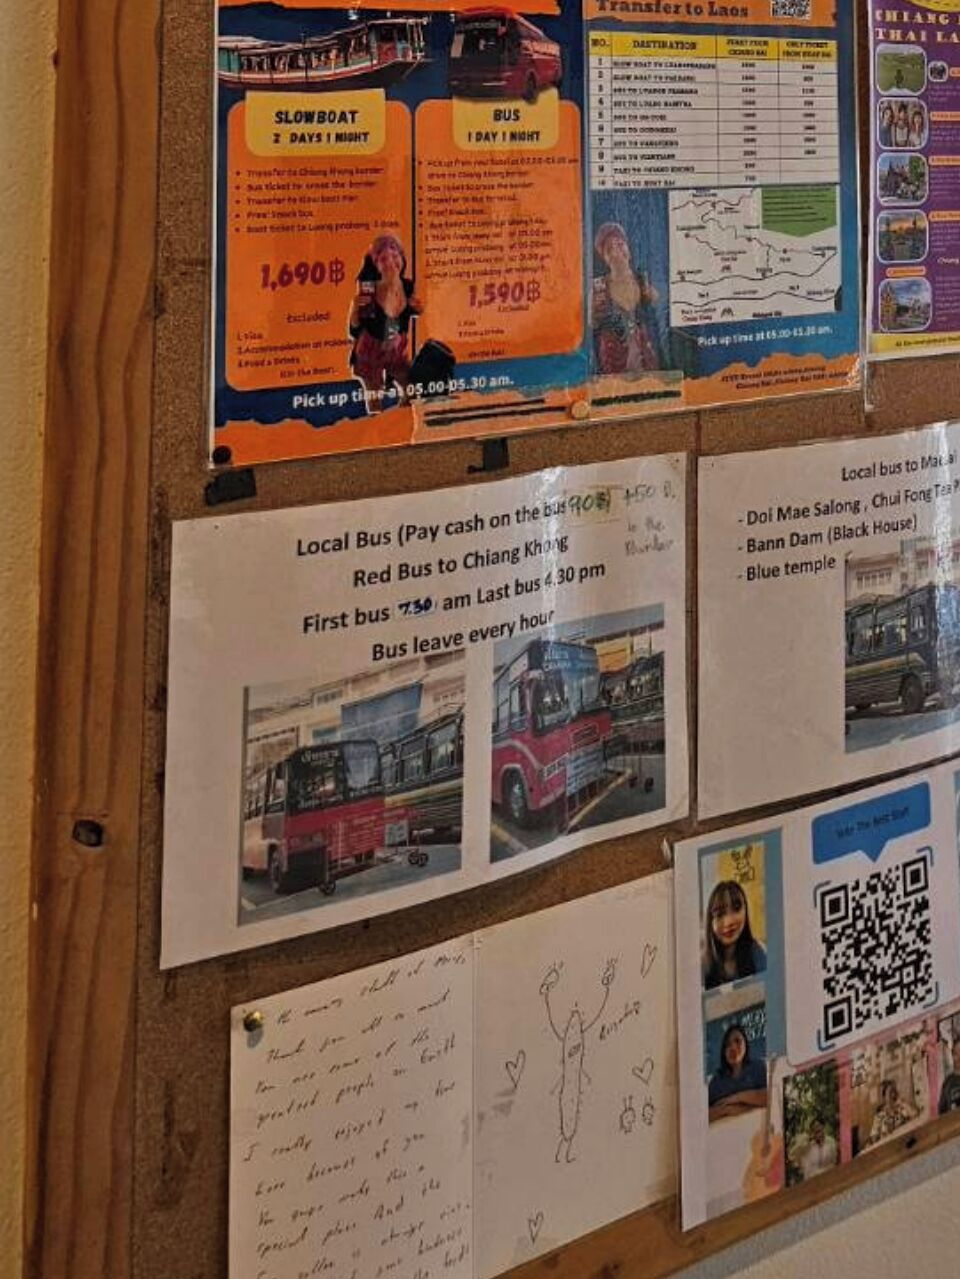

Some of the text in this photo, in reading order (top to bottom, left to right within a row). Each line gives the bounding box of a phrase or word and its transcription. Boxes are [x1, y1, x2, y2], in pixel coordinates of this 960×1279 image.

[685, 0, 703, 16] to
[707, 0, 749, 18] Laos
[875, 10, 950, 26] CHIANG
[274, 109, 359, 125] SLOWBOAT
[493, 108, 520, 122] BUS
[272, 132, 281, 144] 2
[289, 132, 323, 144] DAYS
[335, 131, 370, 143] NIGHT
[475, 131, 498, 142] DAY
[509, 130, 540, 142] NIGHT
[698, 335, 717, 346] Pick
[720, 335, 733, 346] up
[755, 332, 765, 341] at
[293, 392, 325, 409] Pick
[328, 393, 348, 409] up
[489, 375, 514, 386] am.
[841, 463, 876, 482] Local
[879, 459, 903, 478] bus
[904, 459, 919, 473] to
[746, 509, 773, 527] Doi
[776, 503, 811, 522] Mae
[813, 497, 861, 518] Salong
[871, 489, 901, 509] Chui
[904, 486, 932, 505] Fong
[297, 532, 349, 557] Local
[355, 529, 391, 550] Bus
[398, 523, 440, 547] (Pay
[445, 514, 484, 536] cash
[489, 511, 511, 529] on
[515, 507, 540, 525] the
[746, 513, 918, 553] Bann Dam (Black House)
[353, 565, 391, 587] Red
[398, 561, 433, 580] Bus
[437, 558, 457, 574] to
[462, 543, 521, 570] Chiang
[746, 553, 837, 581] Blue temple
[303, 612, 349, 634] First
[354, 607, 390, 626] bus
[443, 594, 471, 611] am
[477, 583, 510, 604] Last
[514, 574, 541, 596] bus
[578, 562, 606, 585] pm
[372, 609, 555, 661] Bus leave every hour
